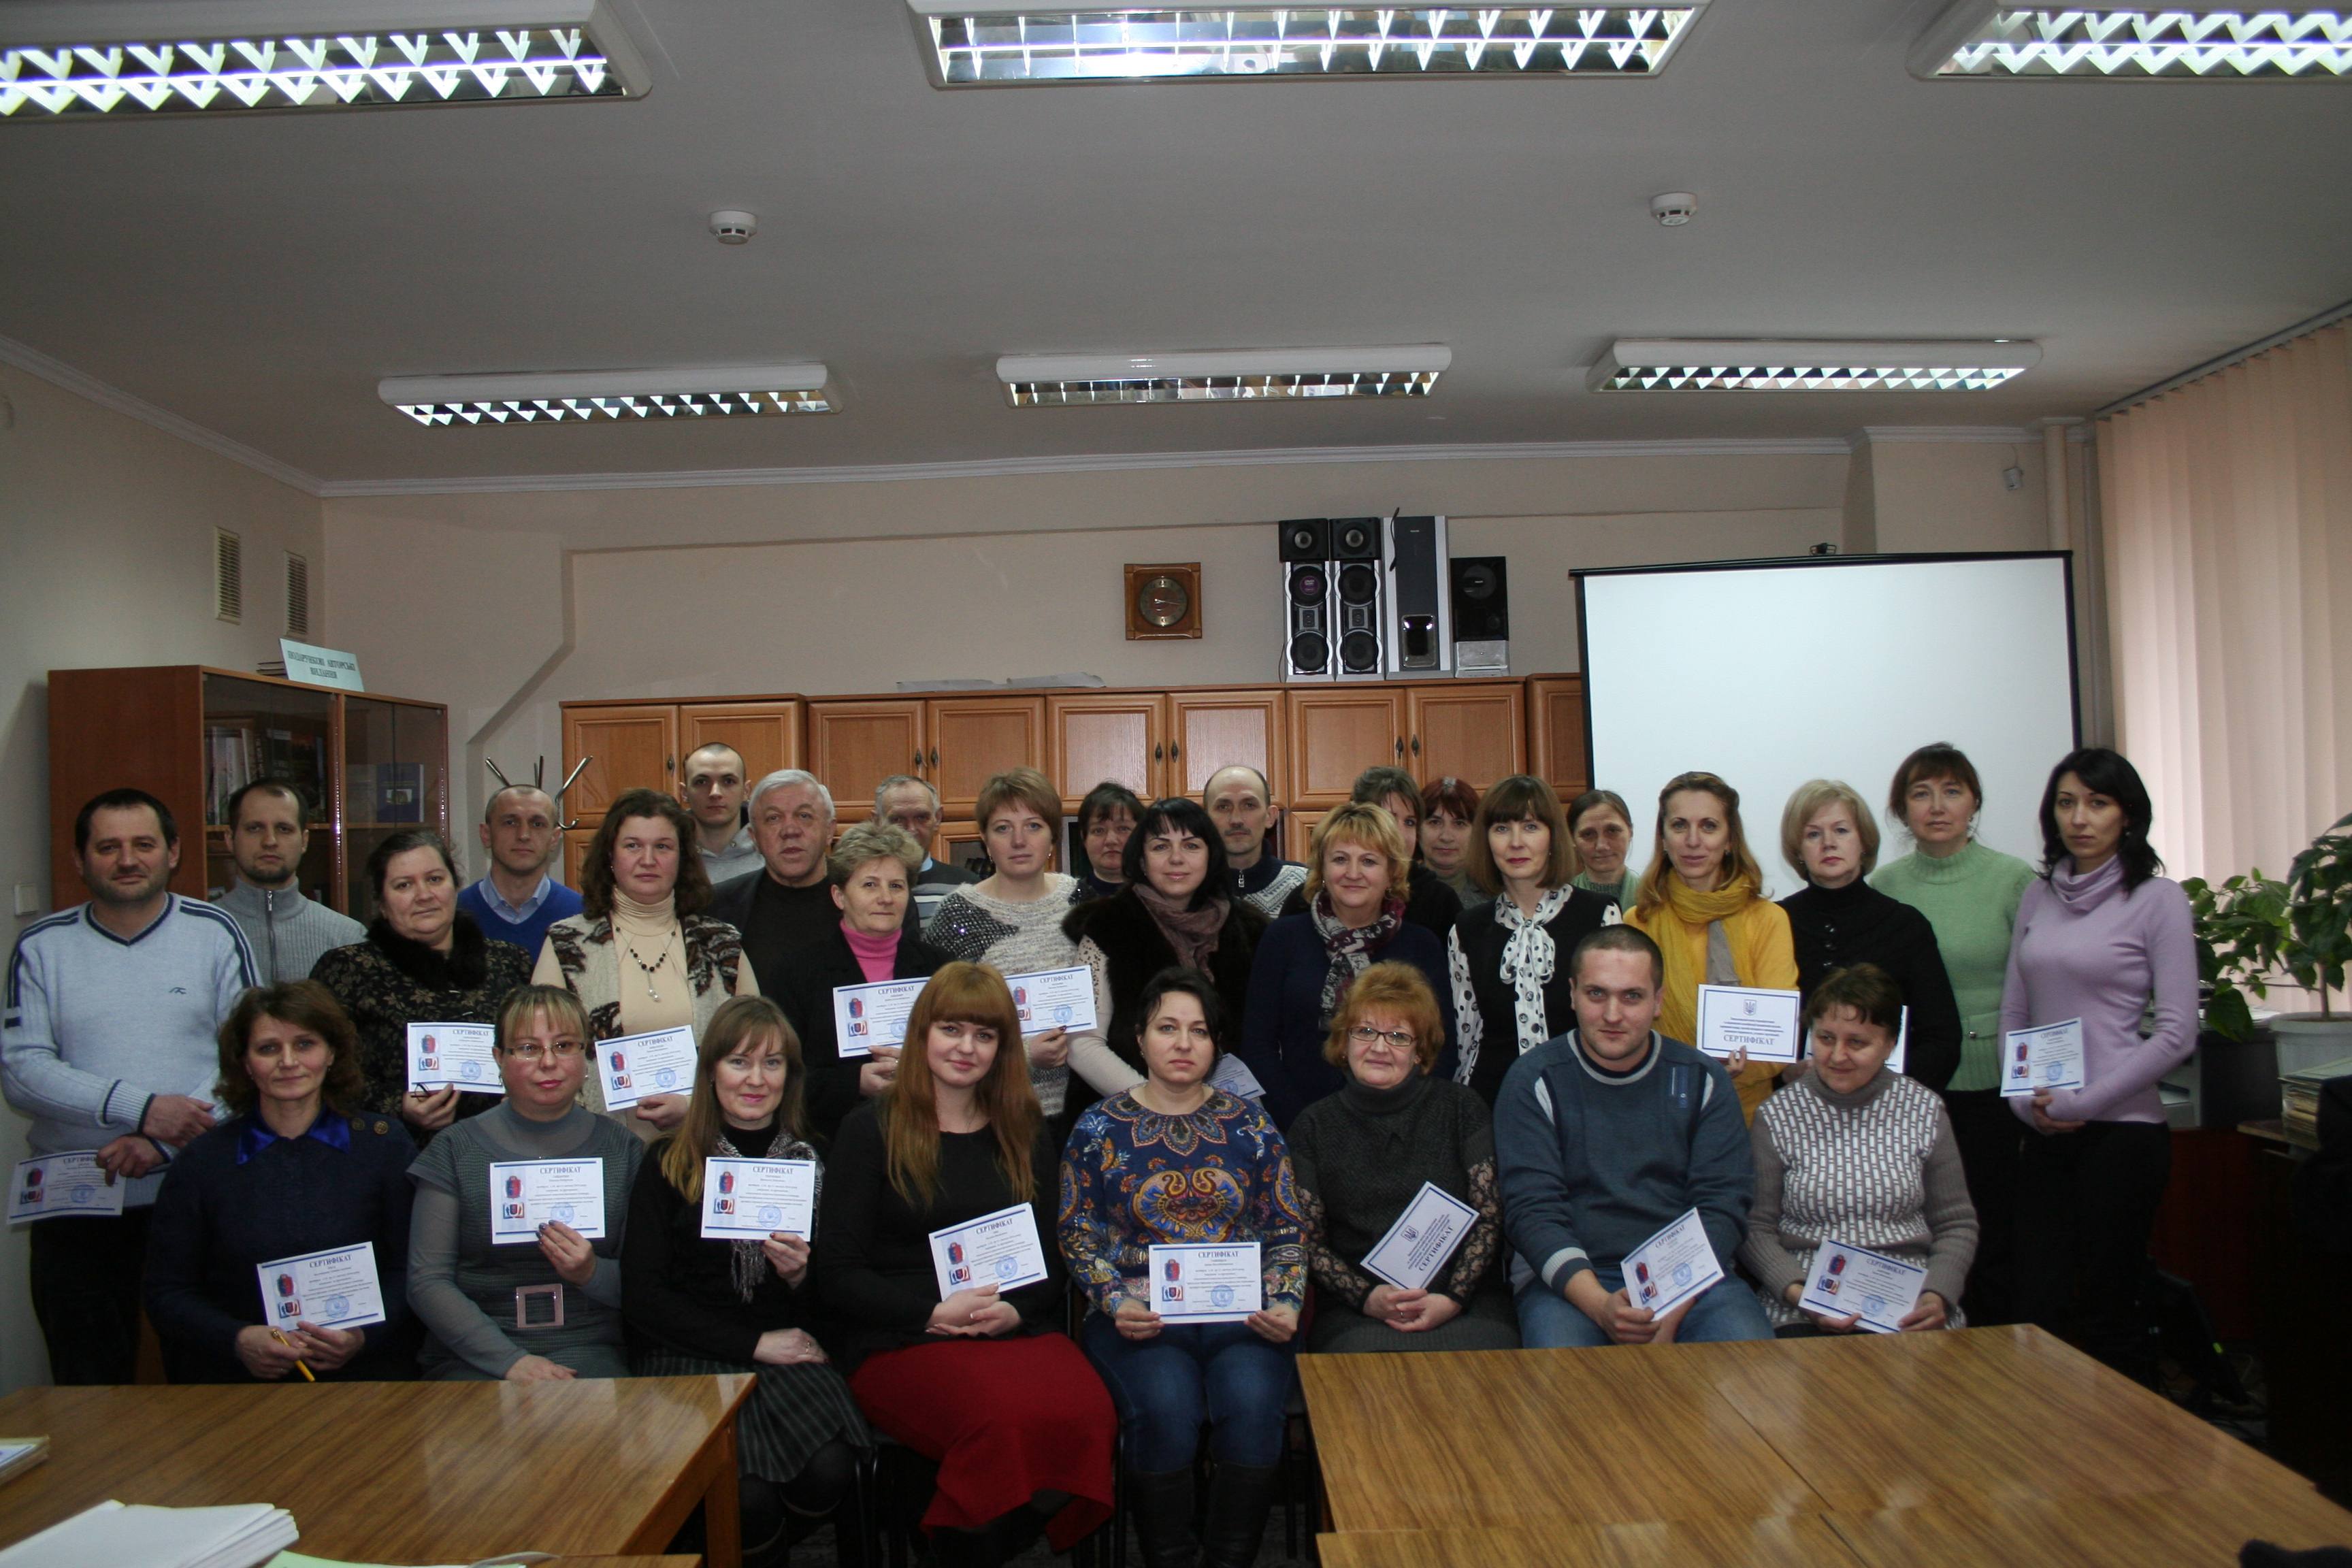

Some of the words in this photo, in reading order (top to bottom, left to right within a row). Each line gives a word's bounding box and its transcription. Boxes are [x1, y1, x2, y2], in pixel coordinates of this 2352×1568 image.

[1040, 974, 1073, 983] СЕРТИФІКАТ
[877, 985, 915, 994] СЕРТИФІКАТ
[638, 1035, 674, 1047] СЕРТИФІКАТ
[1723, 1034, 1776, 1045] СЕРТИФІКАТ
[540, 1166, 582, 1175] СЕРТИФІКАТ
[753, 1166, 794, 1175] СЕРТИФІКАТ
[976, 1218, 1013, 1235] СЕРТИФІКАТ
[1655, 1224, 1685, 1249] СЕРТИФІКАТ
[1418, 1226, 1454, 1271] СЕРТИФІКАТ
[309, 1254, 352, 1268] СЕРТИФІКАТ
[1866, 1258, 1906, 1275] СЕРТИФІКАТ
